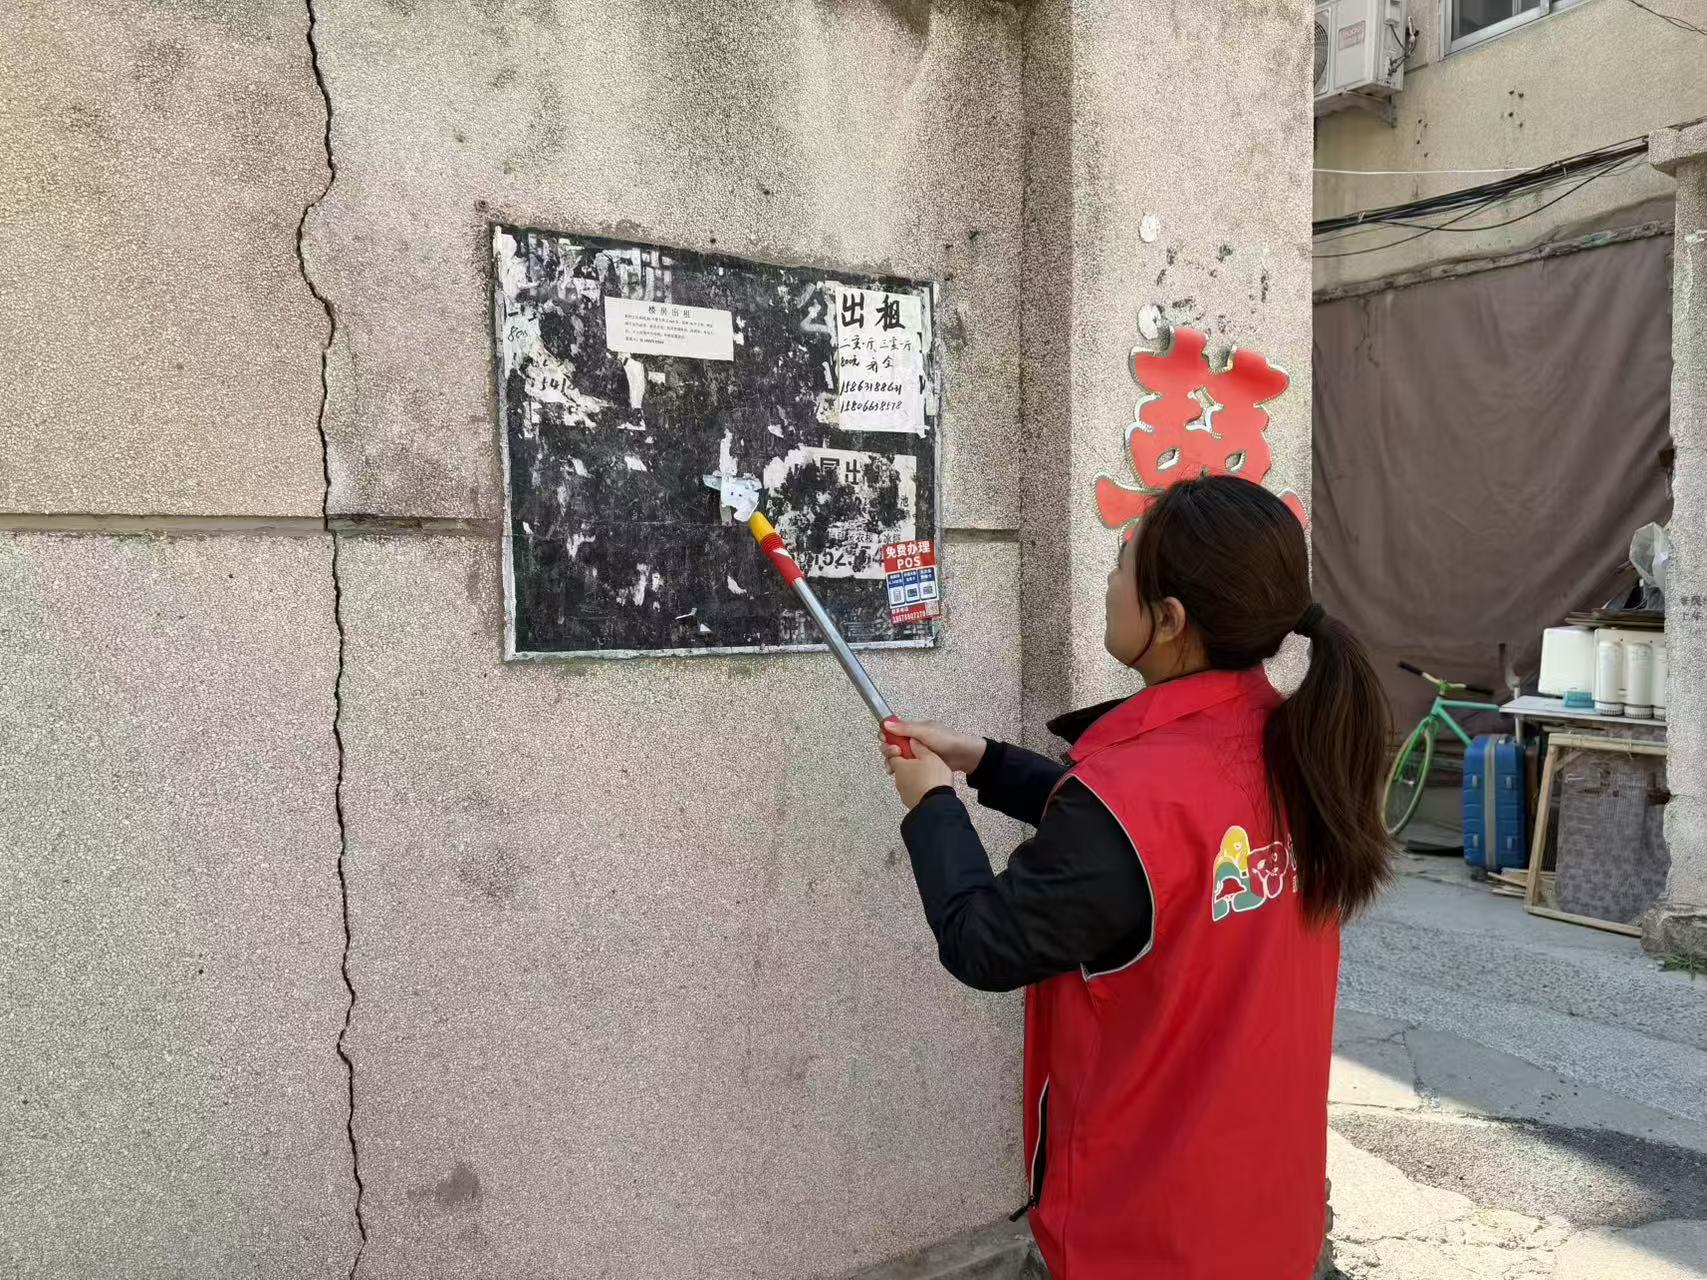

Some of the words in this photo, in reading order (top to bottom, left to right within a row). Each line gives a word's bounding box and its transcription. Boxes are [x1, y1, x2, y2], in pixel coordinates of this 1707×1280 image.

[840, 292, 906, 332] 出租
[885, 540, 931, 559] 免费办理
[896, 555, 921, 570] POS
